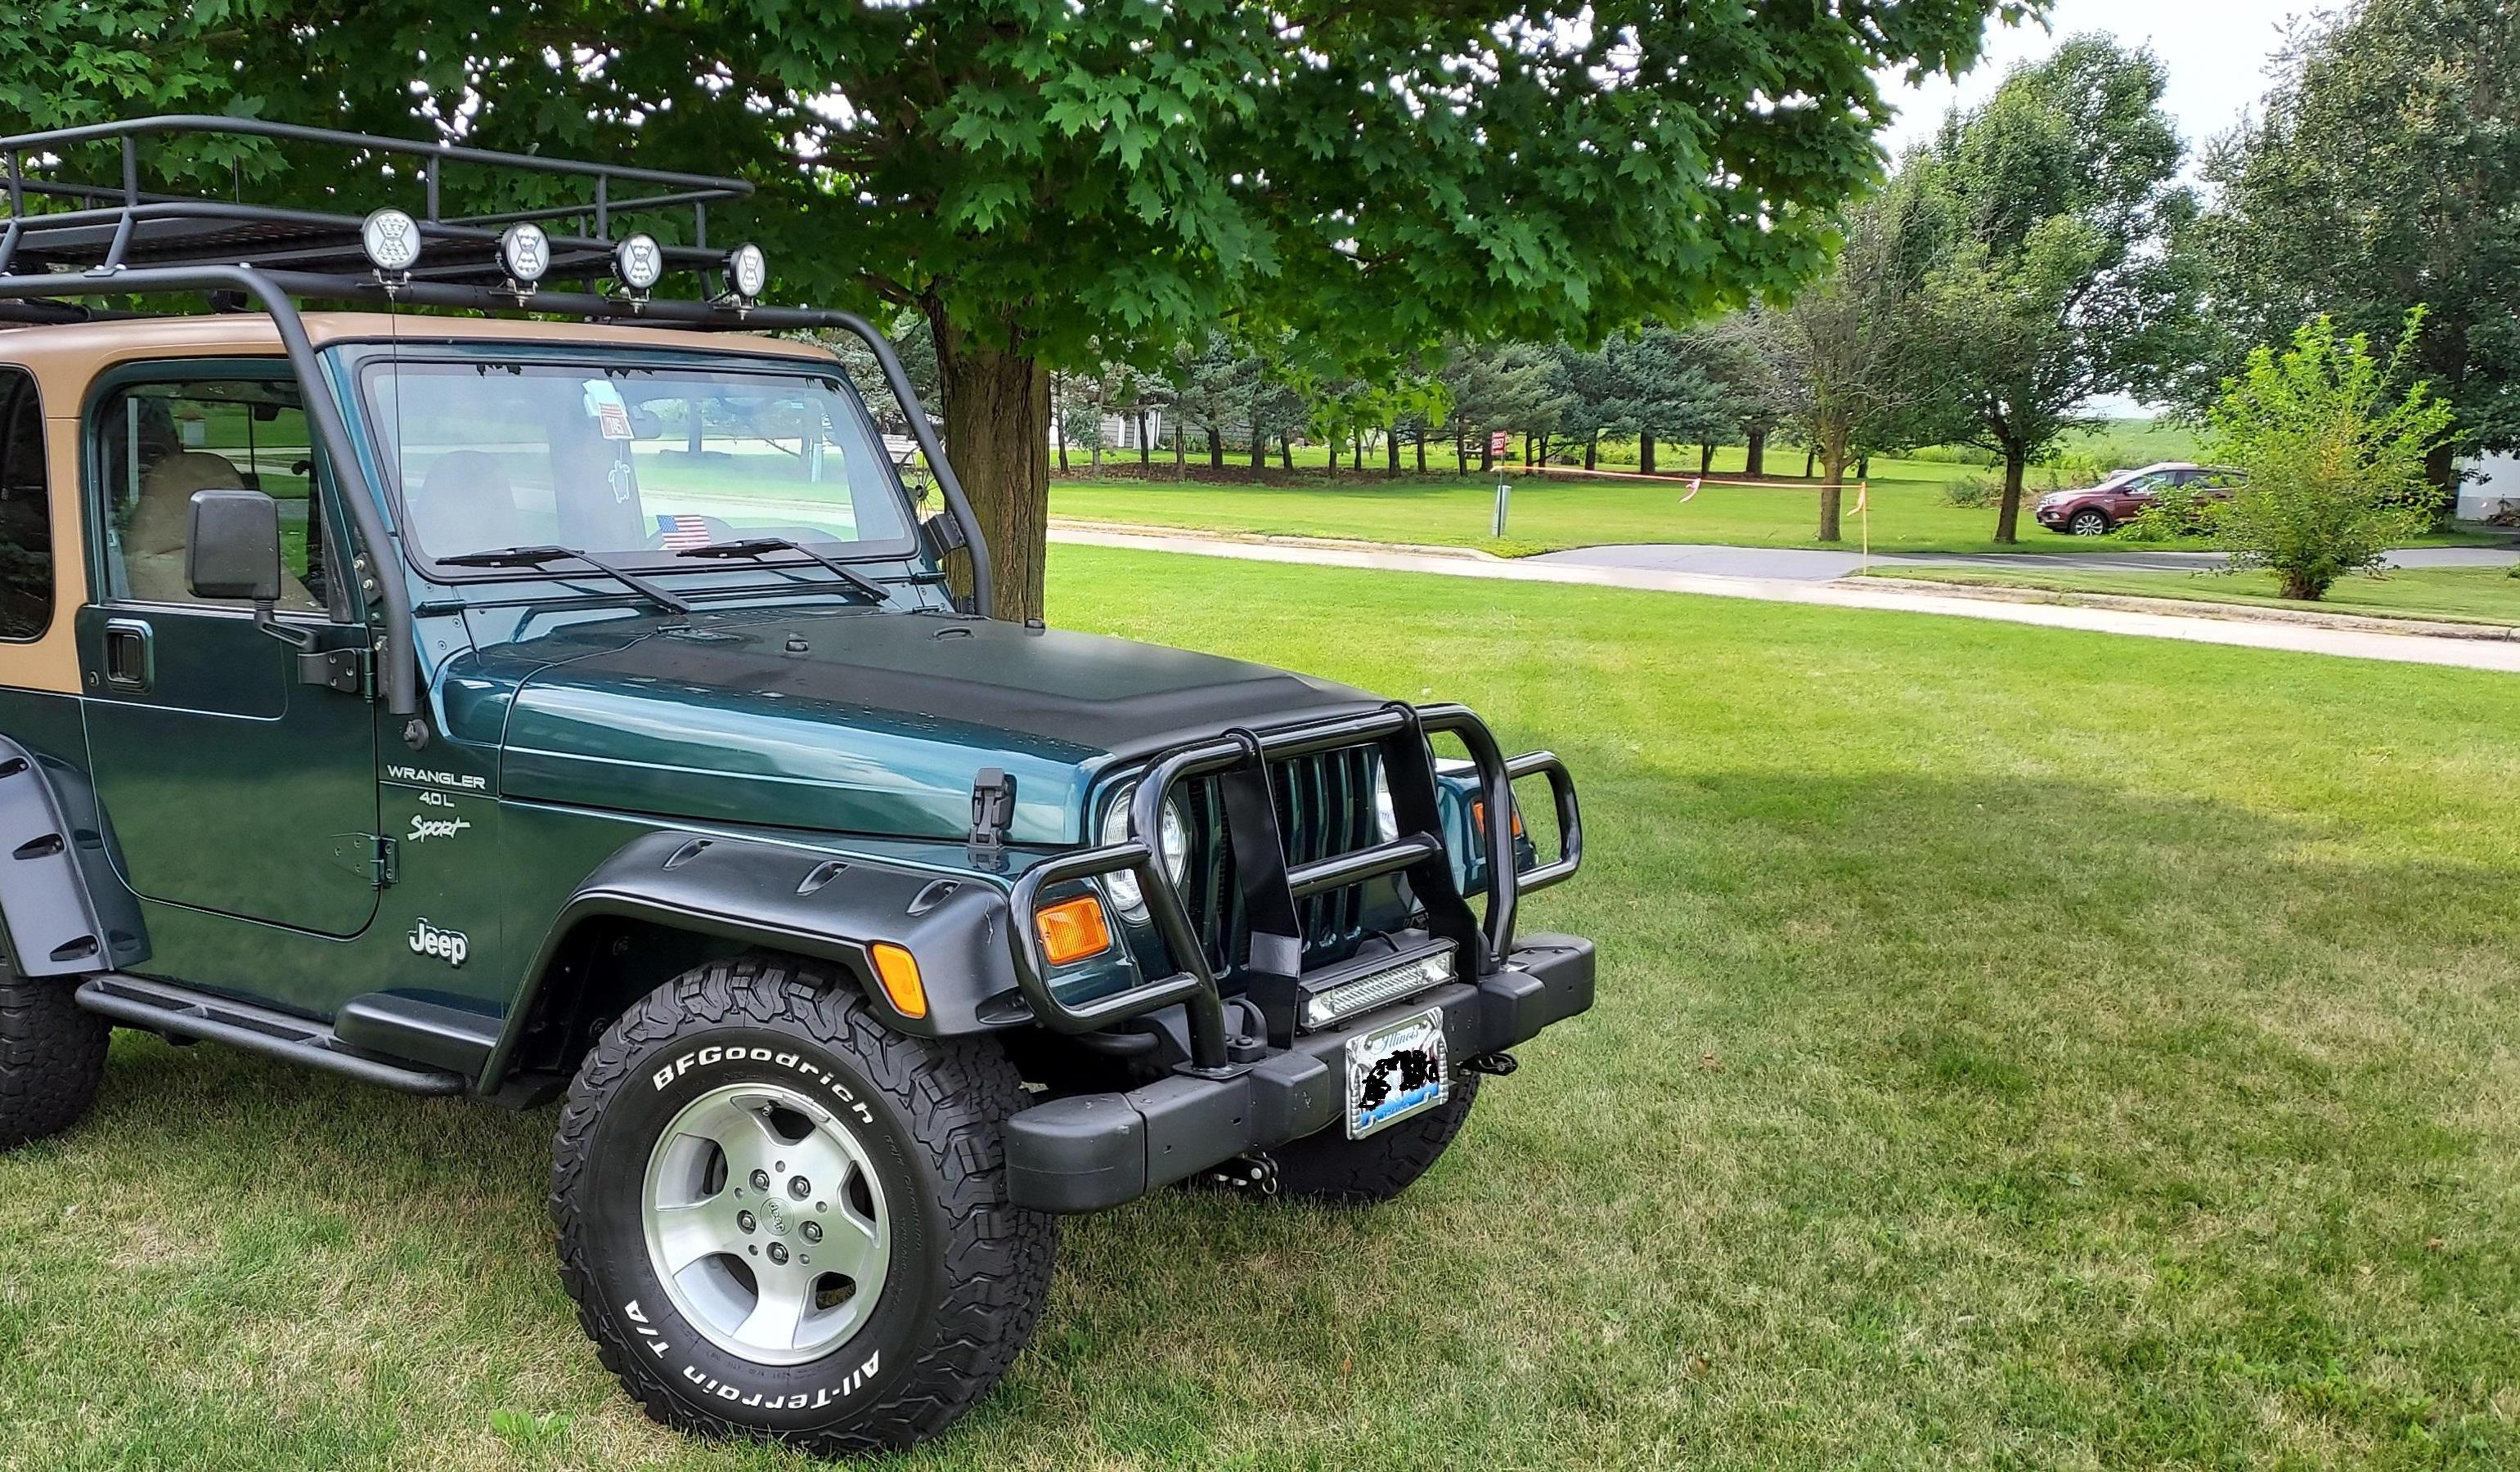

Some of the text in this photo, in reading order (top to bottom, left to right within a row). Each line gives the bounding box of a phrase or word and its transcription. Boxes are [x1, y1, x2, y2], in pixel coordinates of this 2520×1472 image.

[387, 765, 486, 790] WRANGLER
[409, 921, 467, 966] Jeep
[652, 1046, 874, 1124] BFGoodrich
[768, 1201, 785, 1232] Jeep
[624, 1299, 669, 1360] T/A
[682, 1348, 881, 1410] All-Terrain
